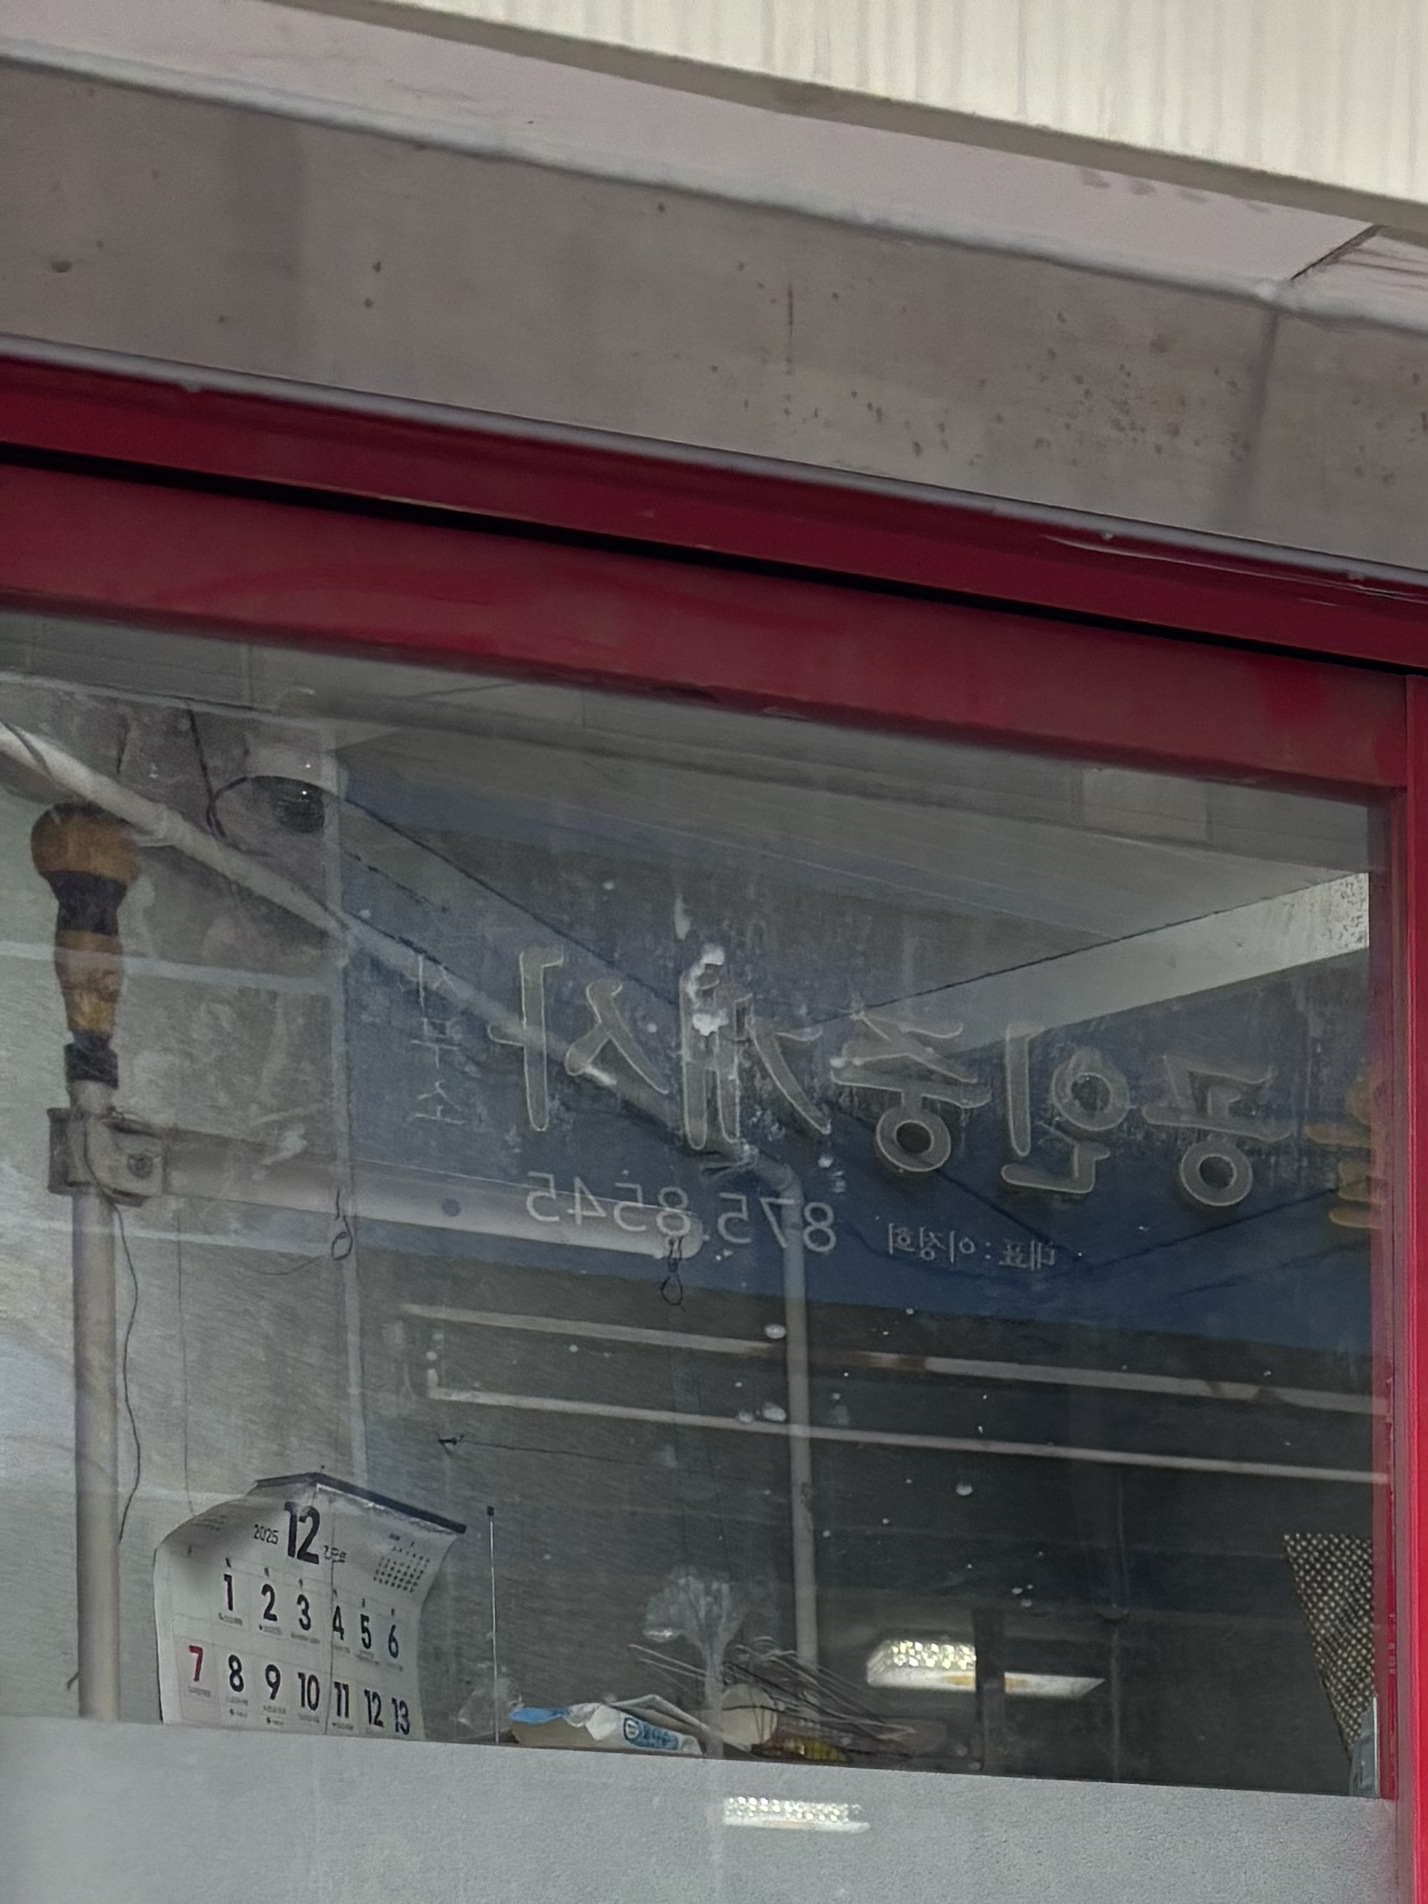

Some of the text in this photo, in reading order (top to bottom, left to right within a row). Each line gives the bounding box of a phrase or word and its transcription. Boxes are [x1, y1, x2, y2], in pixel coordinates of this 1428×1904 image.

[253, 1524, 280, 1546] 2025
[284, 1500, 320, 1565] 12
[223, 1573, 399, 1659] 1 2 3 4 5 6
[189, 1644, 411, 1736] 7 8 9 10 11 12 13
